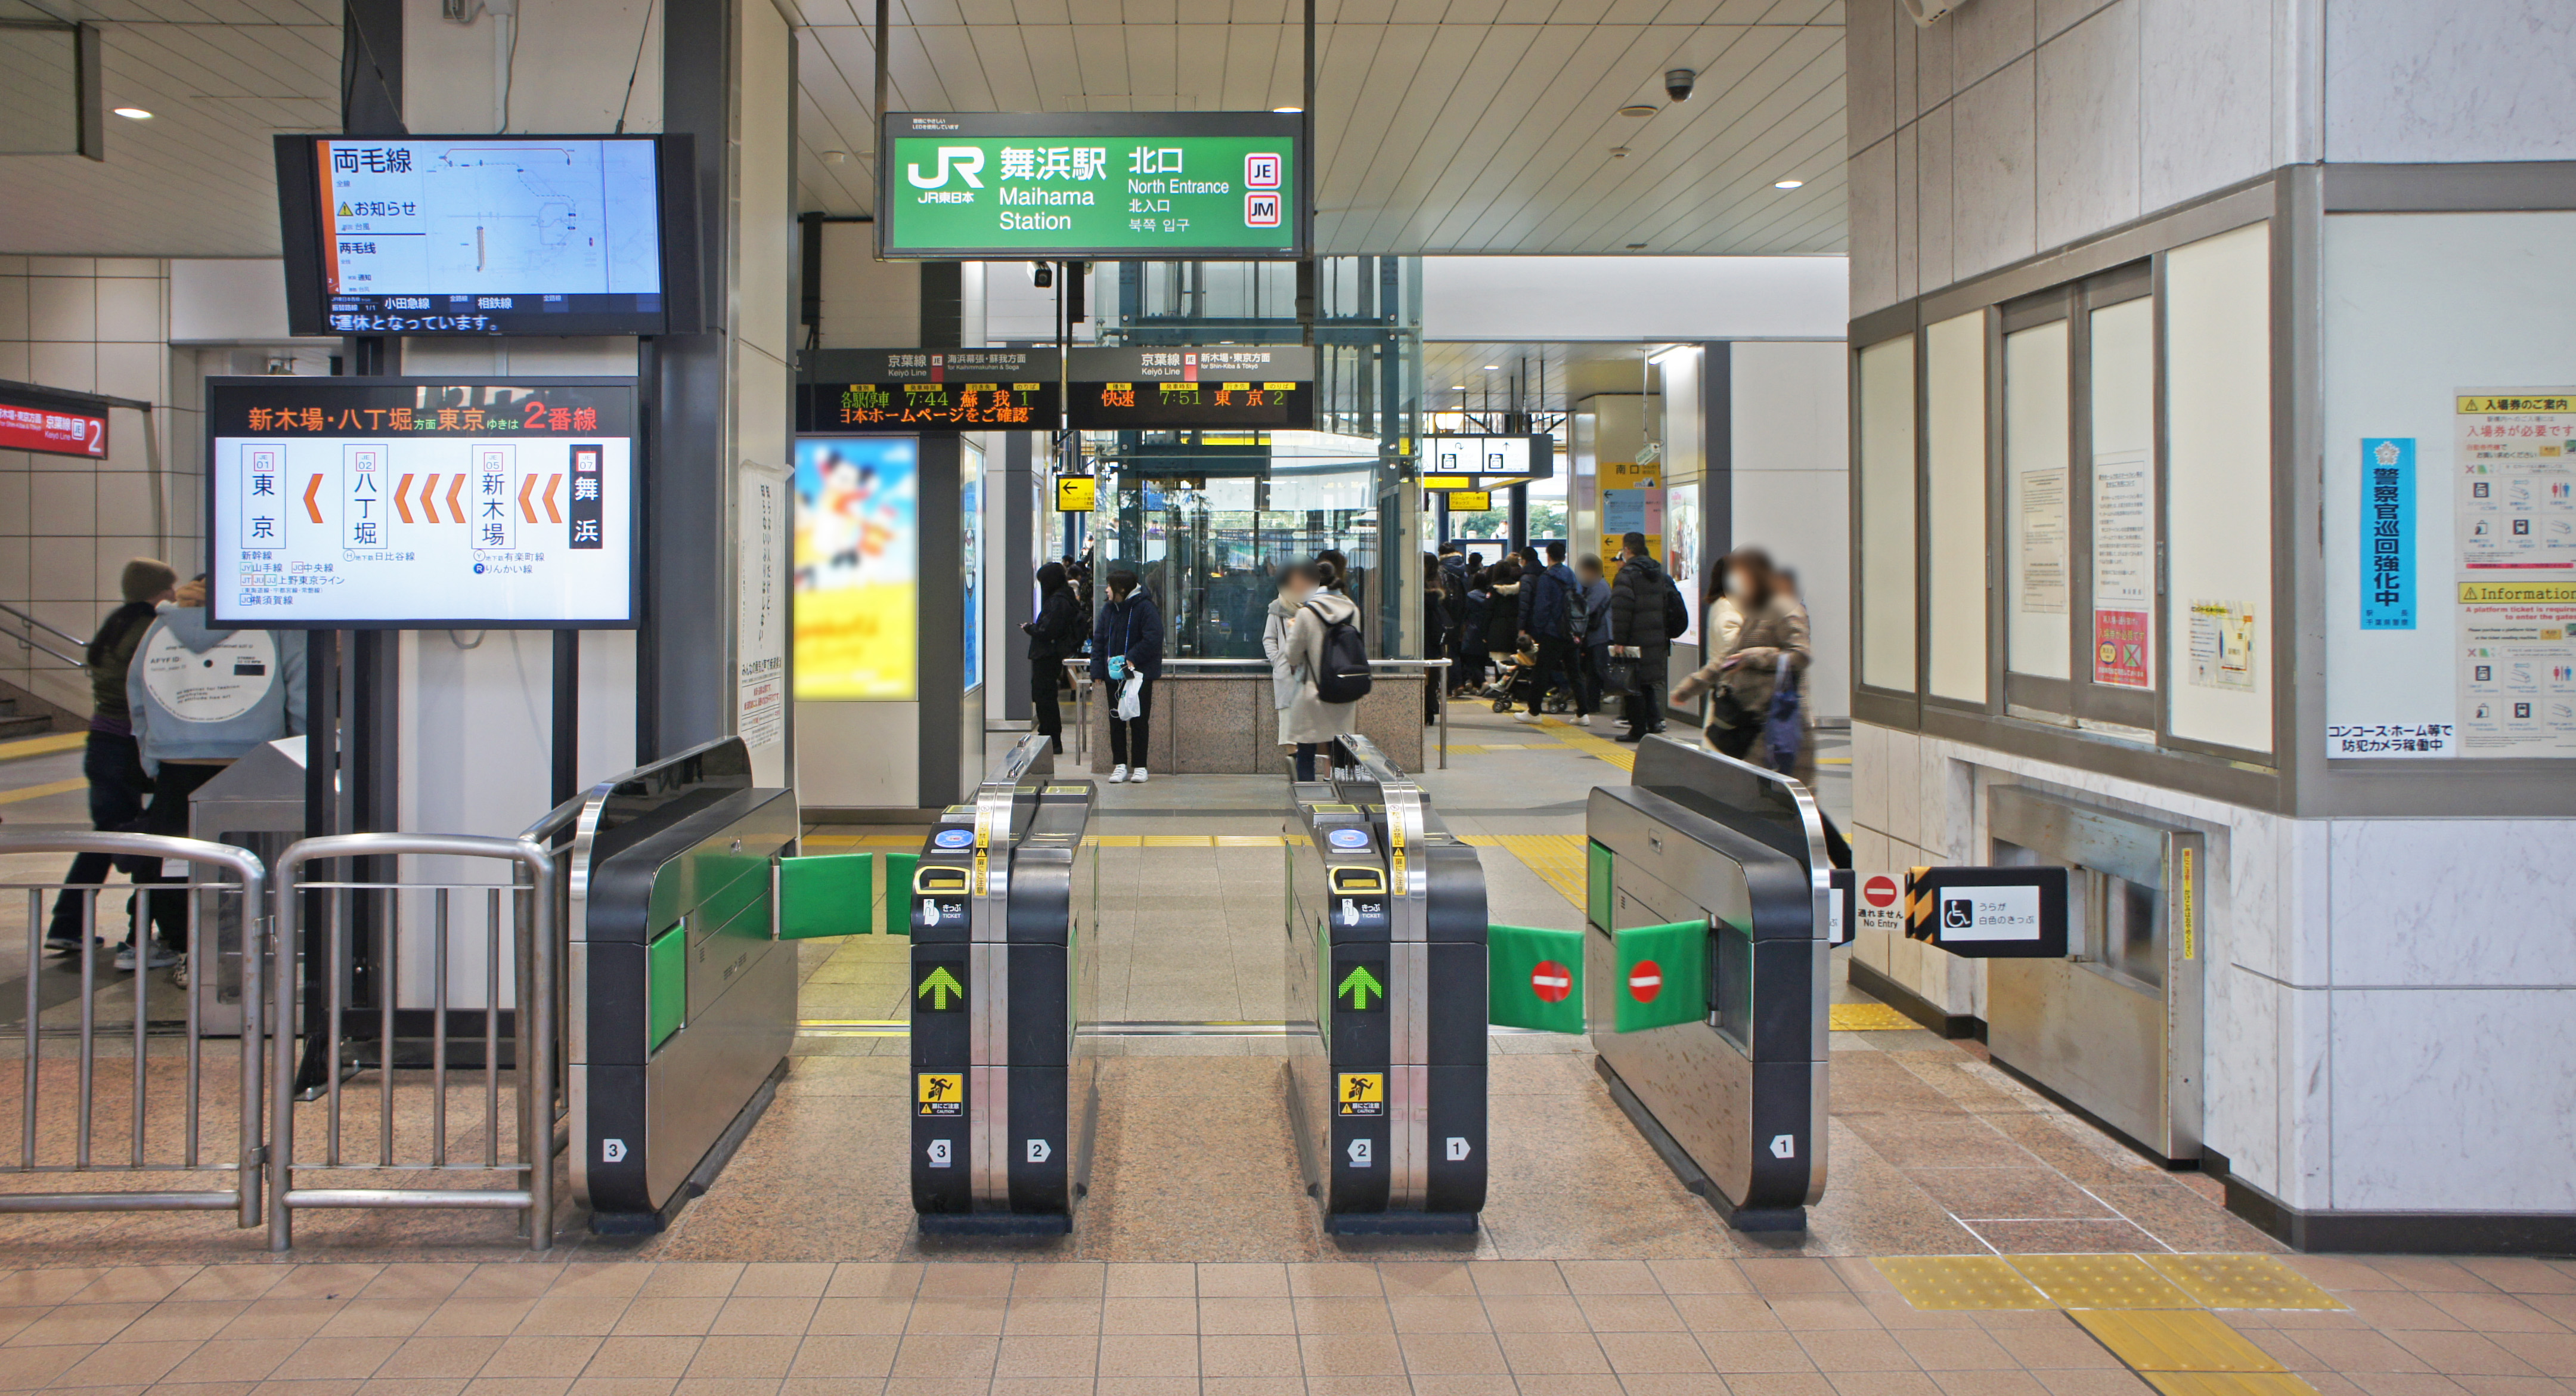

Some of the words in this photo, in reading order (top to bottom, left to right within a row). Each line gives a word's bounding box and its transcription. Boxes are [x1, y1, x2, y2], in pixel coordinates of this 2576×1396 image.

[333, 147, 413, 174] 両毛線
[1000, 146, 1107, 181] 舞浜駅
[1128, 146, 1183, 174] 北口
[908, 147, 985, 189] JR
[1254, 164, 1272, 178] JE
[1128, 178, 1165, 194] North
[1170, 178, 1230, 194] Entrance
[917, 191, 975, 204] JR東日本
[999, 187, 1095, 206] Maihama
[354, 201, 417, 217] お知らせ
[1128, 198, 1170, 213] 北入口
[1251, 202, 1274, 217] JM
[999, 211, 1071, 231] Station
[1128, 218, 1157, 233] 북쪽
[1163, 218, 1191, 233] 입구
[339, 242, 377, 255] 两毛线
[384, 297, 431, 311] 小田急線
[478, 297, 513, 309] 相鉄線
[888, 355, 927, 367] 京葉線
[933, 357, 942, 366] JE
[947, 354, 1027, 364] 海浜幕張・蘇我方面
[1141, 354, 1180, 366] 京葉線
[1186, 355, 1196, 364] JE
[1201, 353, 1271, 363] 新木場・東京方面
[888, 369, 910, 378] Keiyō
[1141, 367, 1163, 377] Keiyō
[841, 391, 889, 408] 各駅停車
[906, 391, 948, 407] 7:44
[960, 389, 1010, 408] 蘇我
[1021, 391, 1029, 406] 1
[1101, 389, 1135, 407] 快速
[1160, 391, 1202, 406] 7:51
[1214, 389, 1264, 407] 東京
[1273, 391, 1284, 406] 2
[2485, 399, 2568, 410] 入場券のご案内
[840, 406, 1034, 424] 日本ホームページをご確認
[45, 415, 71, 431] 京葉線
[74, 425, 82, 434] JE
[60, 432, 71, 441] Line
[88, 420, 102, 453] 2
[2466, 425, 2574, 437] 入場券が必要です
[256, 461, 269, 469] 01
[358, 461, 373, 470] 02
[486, 462, 500, 470] 05
[579, 462, 593, 470] 07
[1616, 465, 1639, 475] 南口
[252, 473, 275, 538] 東京
[354, 473, 377, 544] 八丁堀
[482, 472, 506, 546] 新木場
[574, 476, 599, 543] 舞浜
[2373, 468, 2400, 608] 警察官巡回強化中
[241, 550, 273, 561] 新幹線
[355, 552, 416, 562] 地下鉄日比谷線
[485, 552, 545, 562] 地下鉄有楽町線
[252, 563, 283, 572] 山手線
[303, 563, 334, 572] 中央線
[485, 564, 533, 574] りんかい線
[278, 575, 345, 585] 上野東京ライン
[252, 595, 293, 605] 横須賀線
[2481, 587, 2576, 600] Information
[2098, 627, 2146, 642] 入場券が必要です
[2328, 724, 2453, 737] コンコース・ホーム等で
[2342, 738, 2443, 752] 防犯カメラ稼働中
[942, 903, 962, 912] きっぷ
[1361, 903, 1381, 912] きっぷ
[1979, 902, 2007, 912] うらが
[1857, 908, 1904, 920] 通れません
[1979, 915, 2035, 925] 白色のきっぷ
[1863, 919, 1875, 927] No
[1877, 919, 1898, 929] Entry
[608, 1144, 618, 1157] 3
[937, 1144, 946, 1158] 3
[1033, 1144, 1042, 1157] 2
[1357, 1144, 1367, 1157] 2
[1453, 1142, 1459, 1156] 1
[1780, 1140, 1787, 1153] 1
